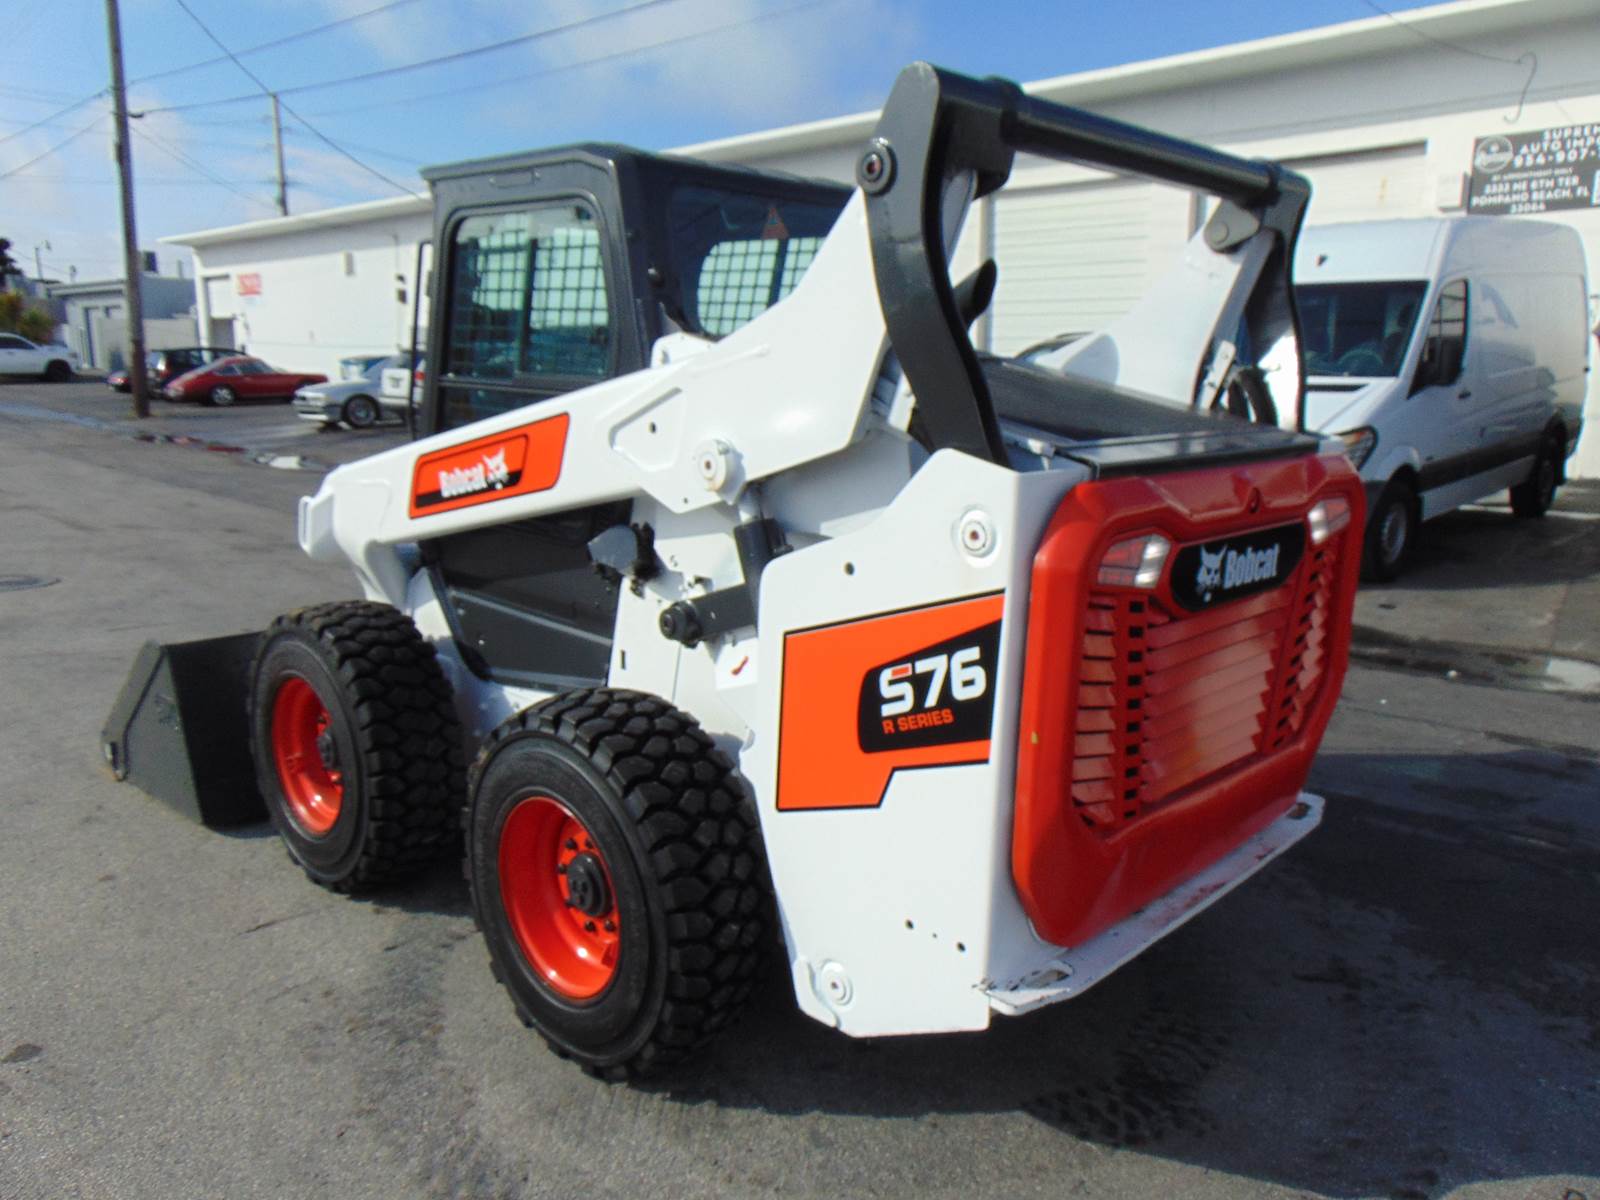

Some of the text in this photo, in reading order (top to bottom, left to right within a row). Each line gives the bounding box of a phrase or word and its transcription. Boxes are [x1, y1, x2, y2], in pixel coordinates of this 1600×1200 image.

[1513, 147, 1600, 168] 954-907-
[1520, 140, 1562, 155] AUTO
[1471, 192, 1529, 208] POMPANO
[1576, 185, 1589, 198] FL
[438, 462, 488, 498] Bobcat
[1223, 543, 1279, 590] Bobcat
[879, 646, 987, 718] S76
[882, 708, 954, 734] R SERIES
